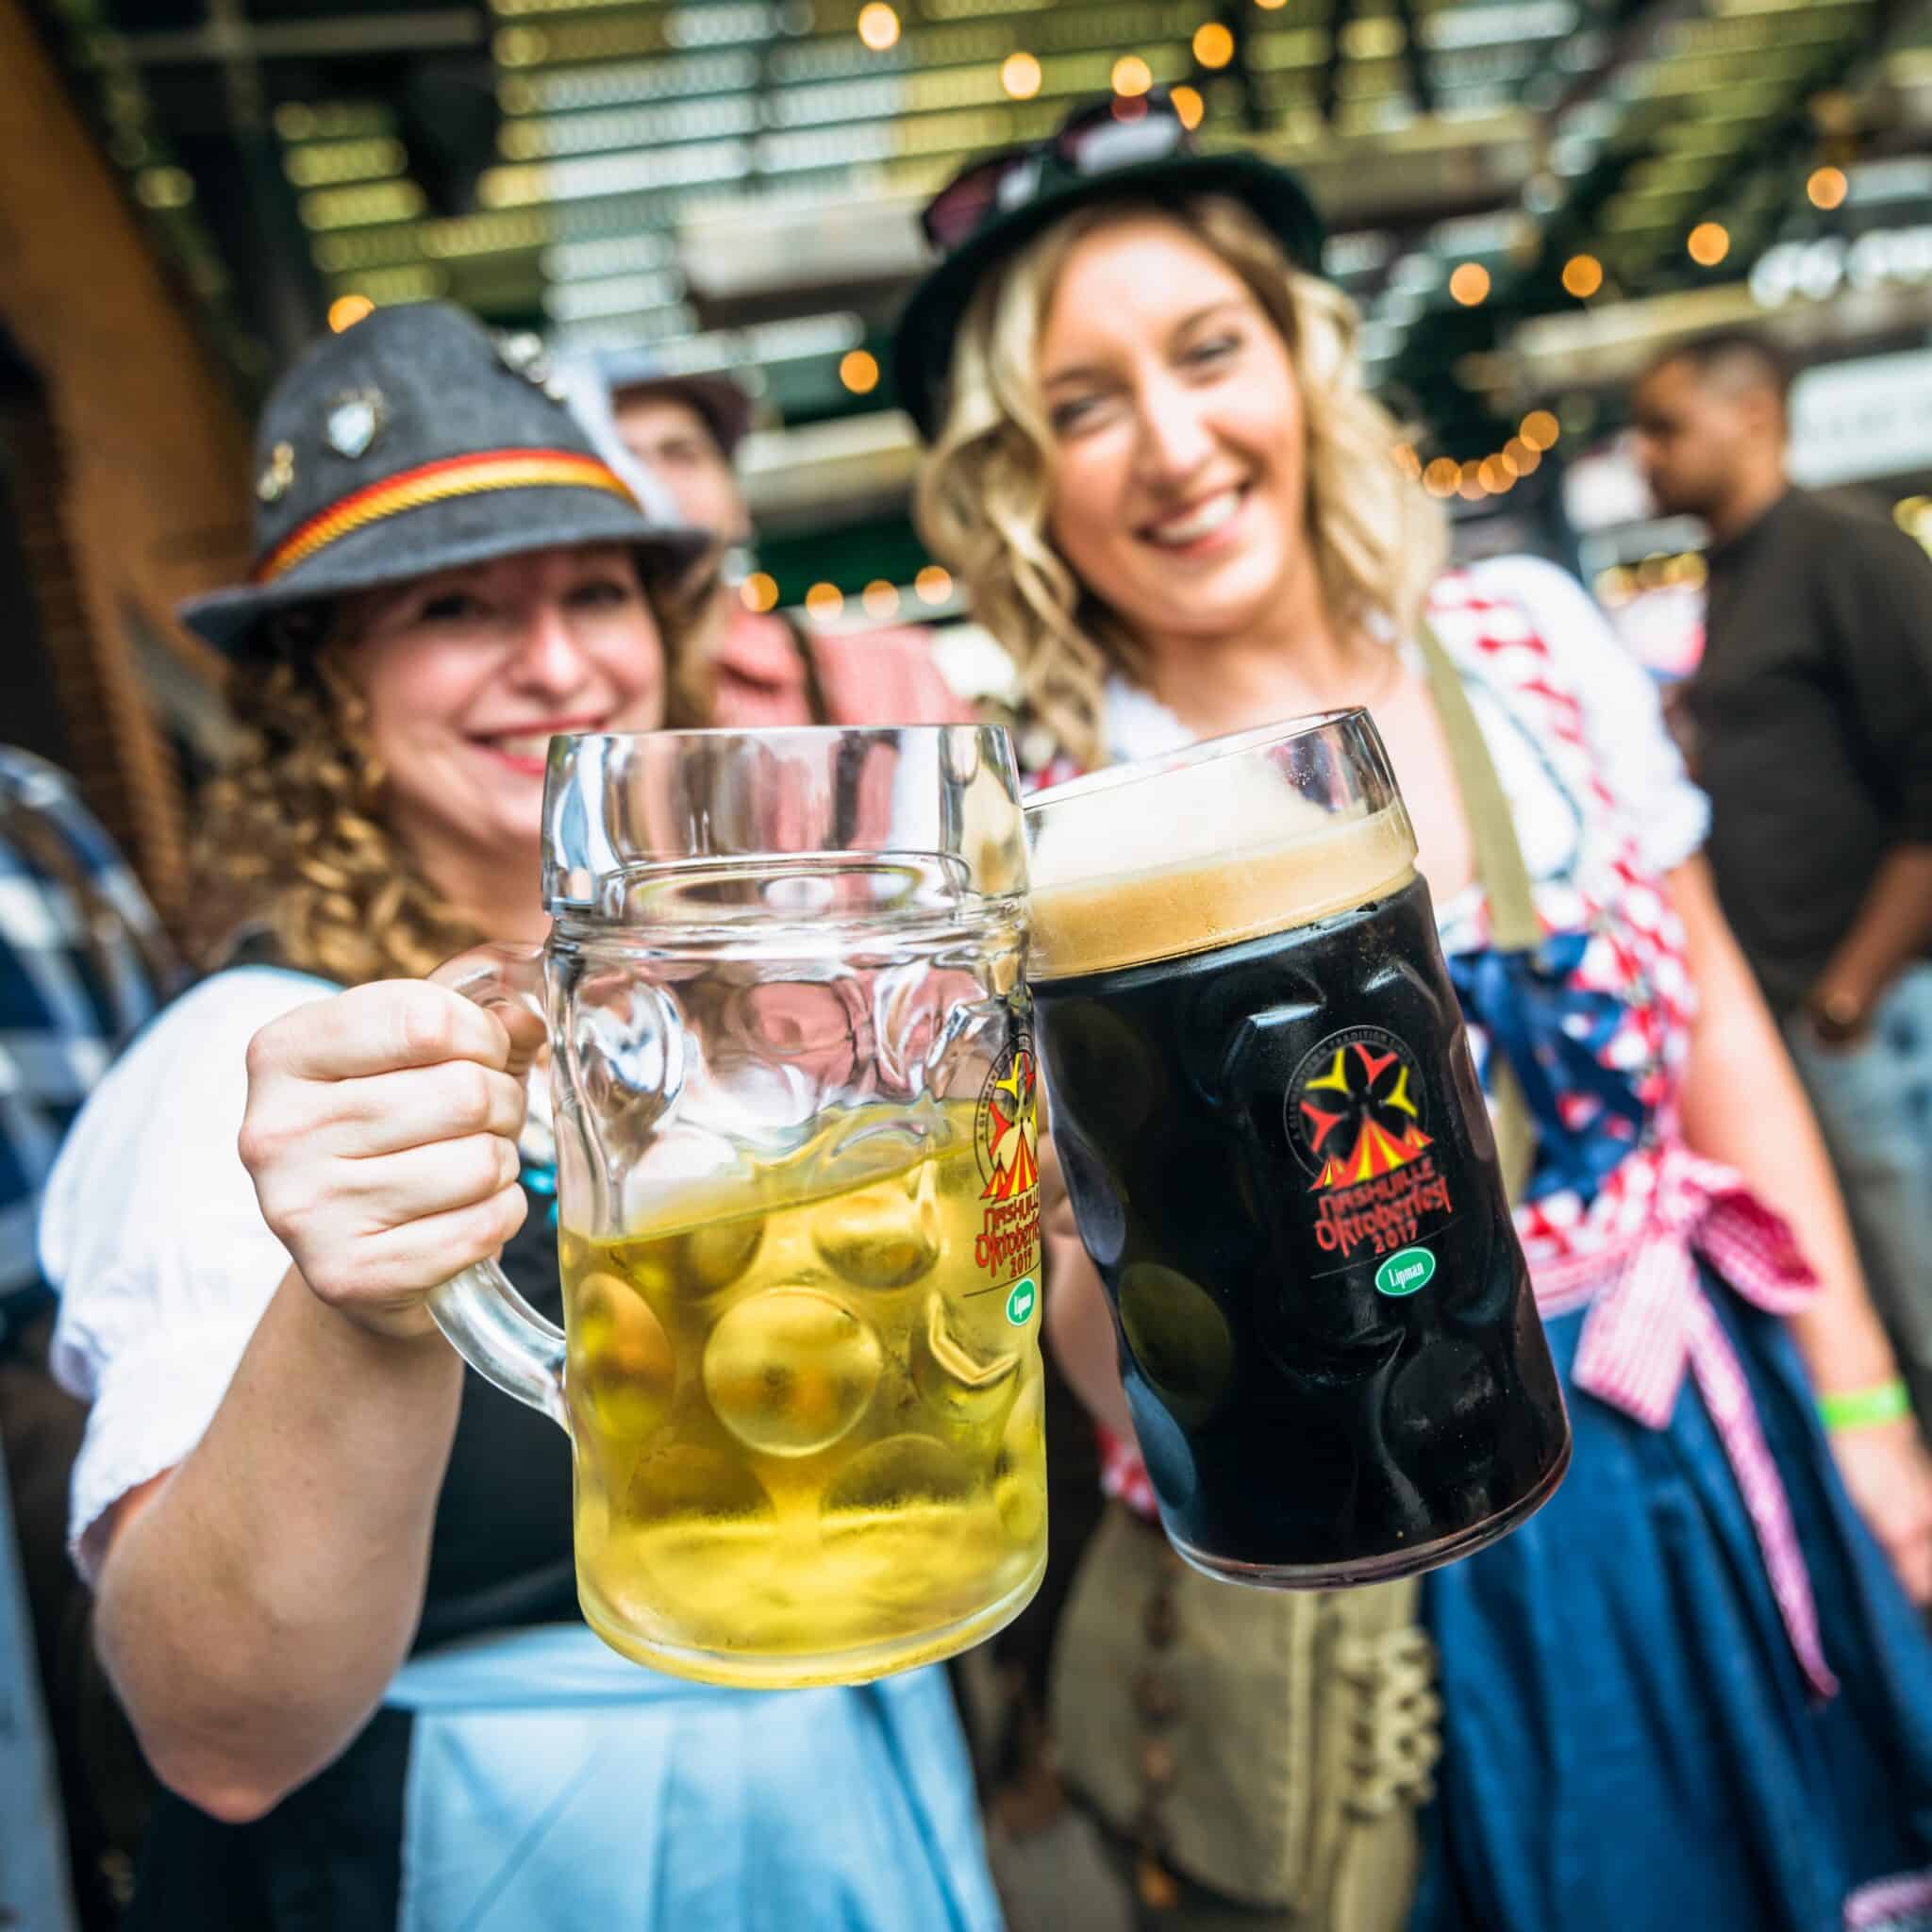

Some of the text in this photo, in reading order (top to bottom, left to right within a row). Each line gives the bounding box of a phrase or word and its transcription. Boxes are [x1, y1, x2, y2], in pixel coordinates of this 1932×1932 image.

[984, 1187, 1039, 1235] NASHVILL
[1319, 1157, 1436, 1220] NASHVILLE
[974, 1212, 1041, 1278] Oktoberf
[1314, 1176, 1453, 1259] Oktoberfest
[1373, 1219, 1418, 1255] 2017
[1388, 1261, 1425, 1290] Lipman
